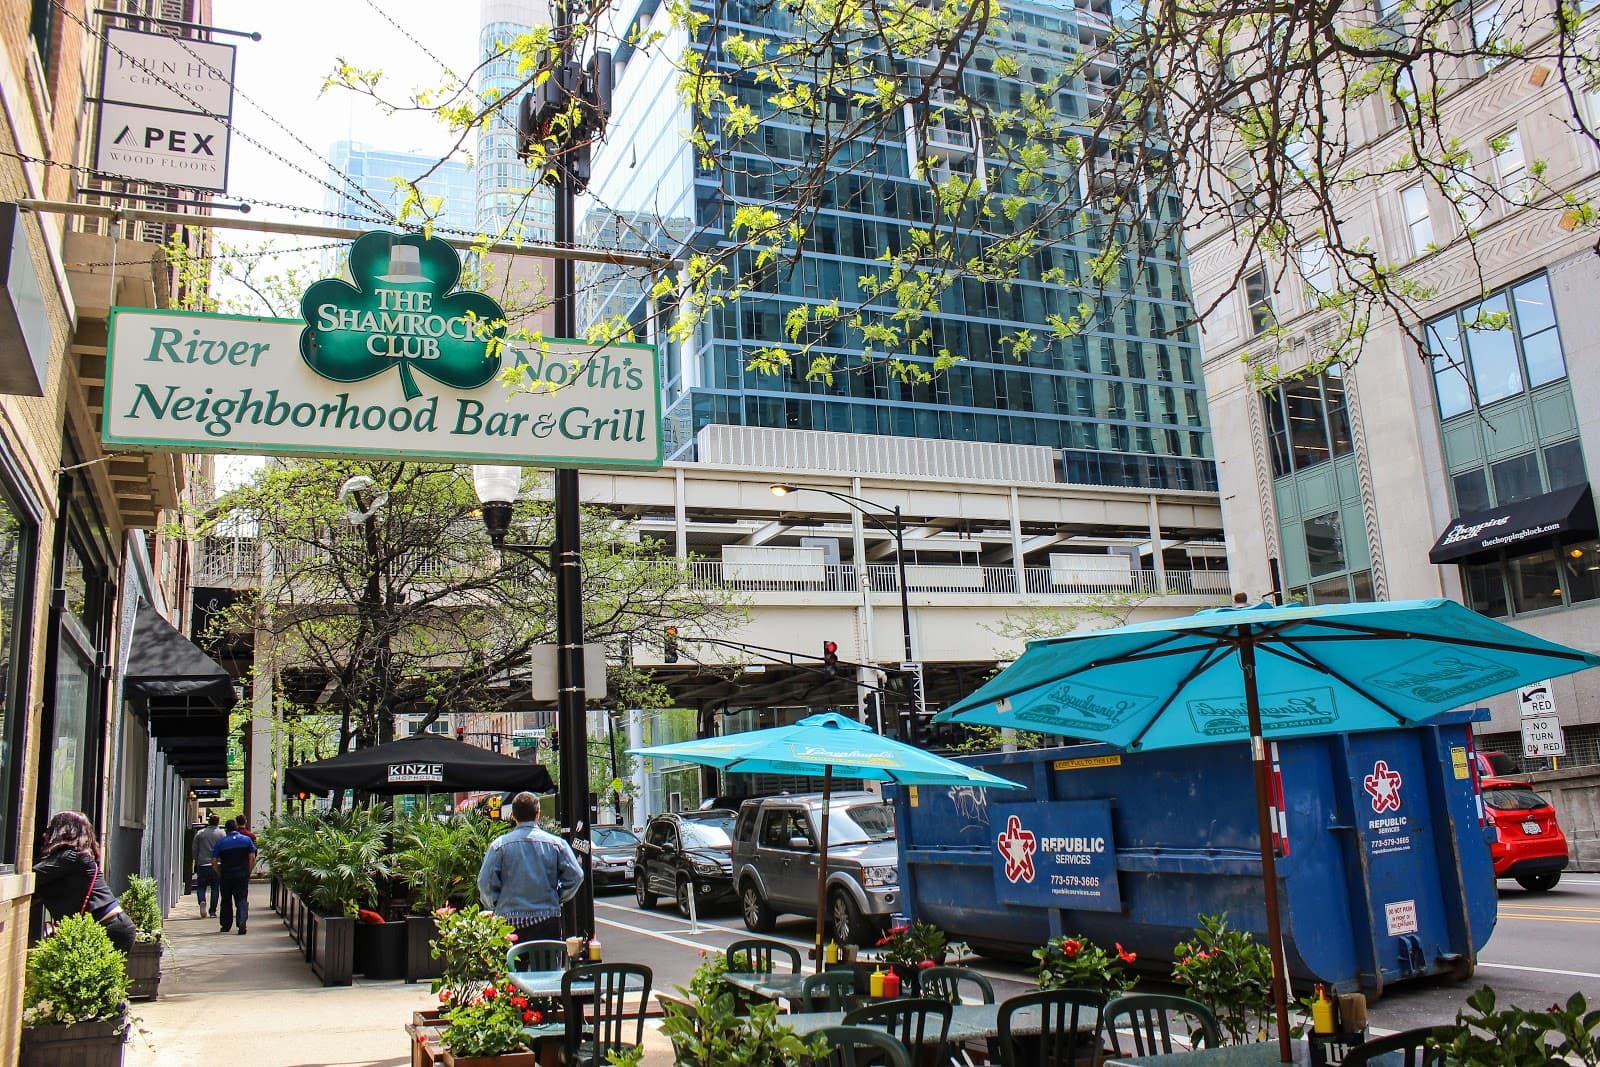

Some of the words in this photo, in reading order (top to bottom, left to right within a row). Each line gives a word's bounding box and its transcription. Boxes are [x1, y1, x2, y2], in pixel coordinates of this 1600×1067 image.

[129, 75, 204, 92] CHIAGO
[113, 125, 214, 156] APEX
[110, 152, 154, 165] WOOD
[161, 159, 217, 172] FLOORS
[375, 288, 433, 314] THE
[144, 326, 271, 367] River
[366, 334, 441, 360] CLUB
[124, 383, 439, 437] Neighborhood
[450, 398, 529, 437] Bar
[558, 406, 646, 443] Grill
[1481, 522, 1560, 548] thechoppingblock.com
[1532, 700, 1552, 711] RED
[1533, 721, 1548, 731] NO
[1530, 732, 1554, 741] TURN
[1527, 744, 1538, 753] ON
[1543, 742, 1560, 751] RED
[390, 764, 442, 775] KINZIE
[1369, 817, 1407, 829] REPUBLIC
[1041, 837, 1105, 853] REPUBLIC
[1055, 855, 1091, 865] SERVICES
[1050, 875, 1099, 887] 773-579-3605
